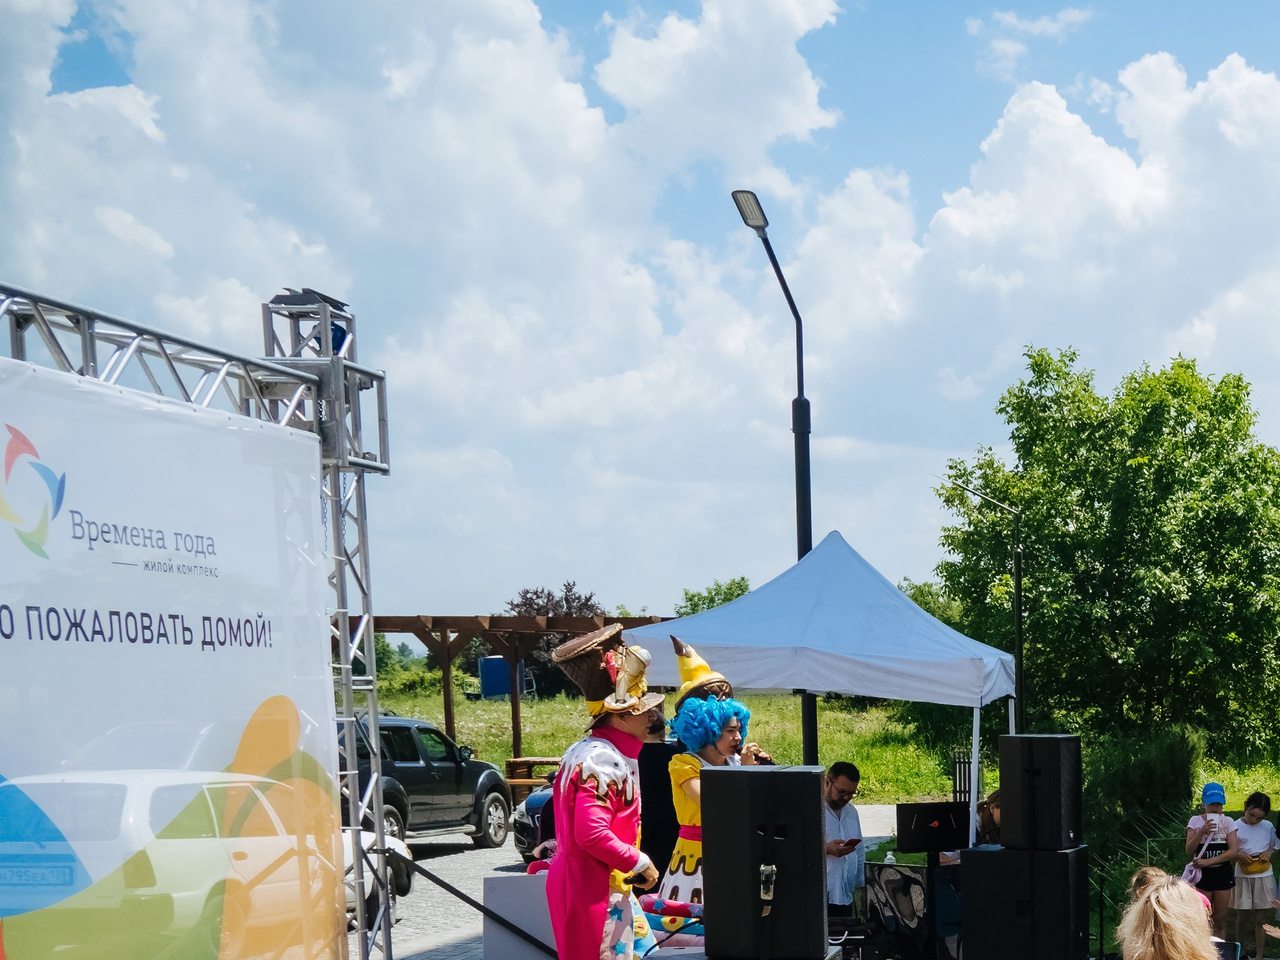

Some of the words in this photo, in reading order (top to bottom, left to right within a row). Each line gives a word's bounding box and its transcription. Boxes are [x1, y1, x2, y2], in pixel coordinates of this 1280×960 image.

[68, 509, 168, 551] Времена
[173, 531, 217, 559] года
[142, 557, 174, 574] жилой
[176, 562, 219, 578] комплекс
[25, 605, 194, 645] ПОЖАЛОВАТЬ
[201, 611, 273, 652] ДОМОЙ!
